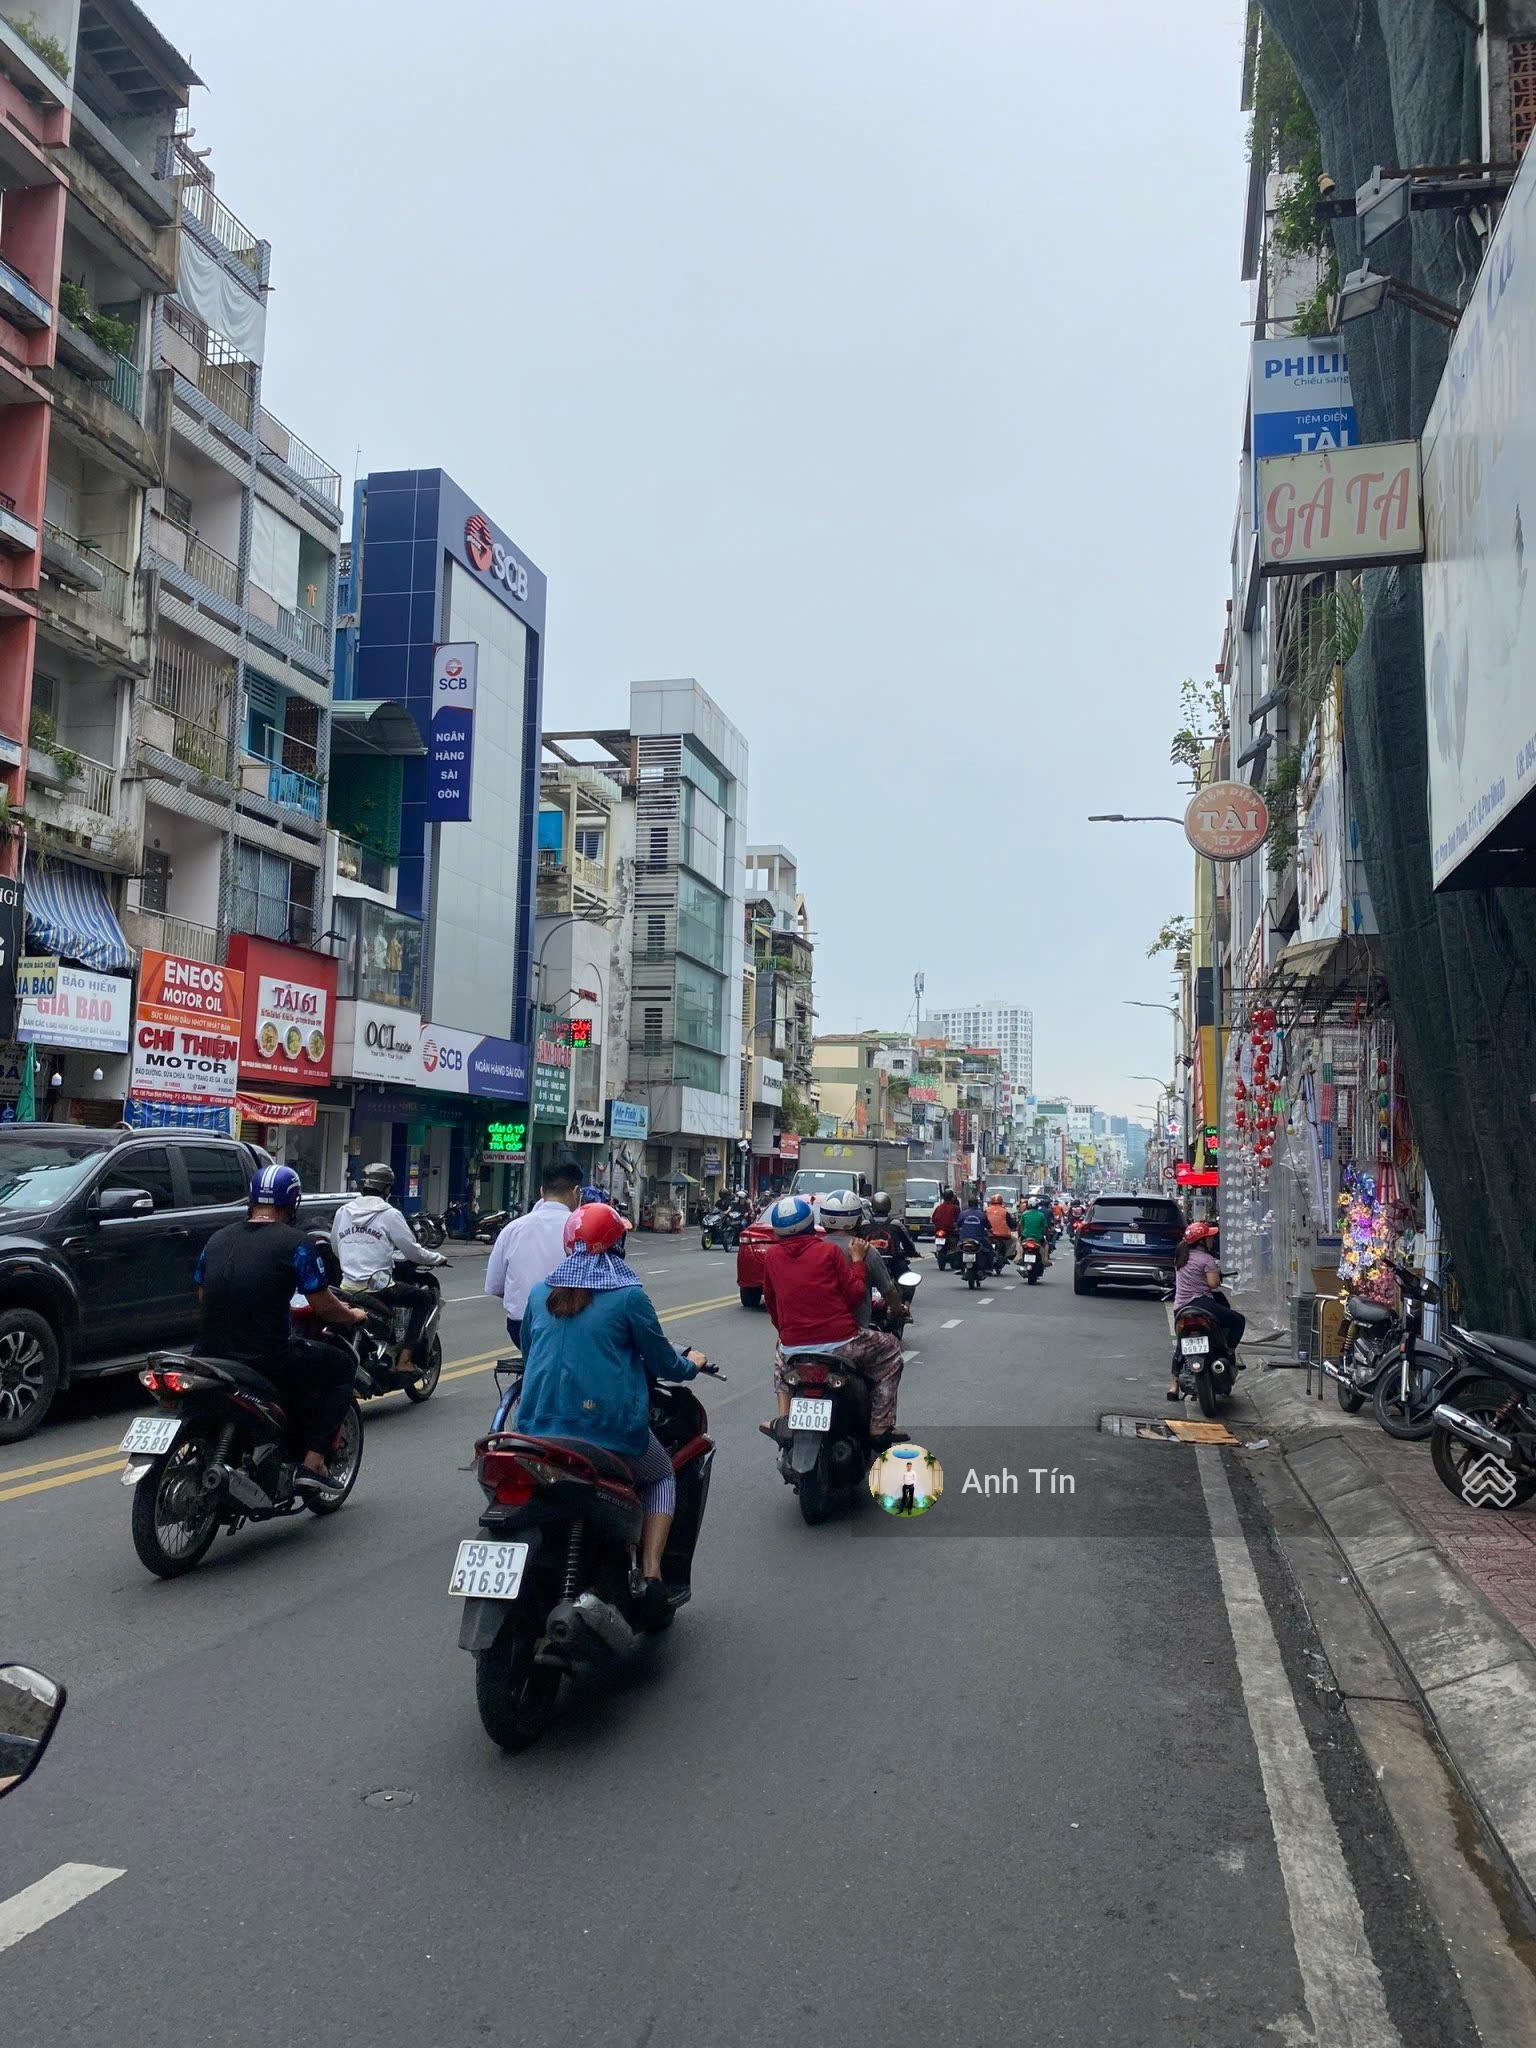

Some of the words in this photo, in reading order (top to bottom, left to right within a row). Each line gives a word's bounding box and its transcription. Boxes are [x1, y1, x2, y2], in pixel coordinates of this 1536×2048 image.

[1294, 426, 1348, 454] TÀI
[1267, 454, 1334, 560] GÀ
[1346, 467, 1410, 540] TA
[492, 543, 529, 602] SCB
[439, 677, 467, 691] SCB
[436, 730, 465, 742] NGÂN
[435, 748, 465, 762] HÀNG
[440, 767, 458, 780] SÀI
[437, 786, 460, 799] GÒN
[1198, 804, 1259, 832] TÀI
[0, 886, 18, 908] GI
[18, 975, 29, 995] IA
[32, 970, 54, 995] BẢO
[164, 959, 224, 993] ENEOS
[163, 987, 203, 1009] MOTOR
[205, 996, 222, 1012] OIL
[302, 993, 318, 1016] 61
[138, 1026, 175, 1052] CHÍ
[181, 1033, 238, 1062] THIỆN
[365, 1021, 397, 1050] OCI
[146, 1053, 227, 1075] MOTOR
[440, 1047, 462, 1071] SCB
[475, 1059, 490, 1073] NGÂN
[491, 1061, 505, 1076] HÀNG
[796, 1400, 825, 1414] 59-E1
[135, 1420, 171, 1435] 59-V1
[791, 1414, 828, 1429] 940.08
[123, 1435, 170, 1451] 975.88
[466, 1545, 515, 1570] 59-S1
[454, 1569, 518, 1595] 316.97
